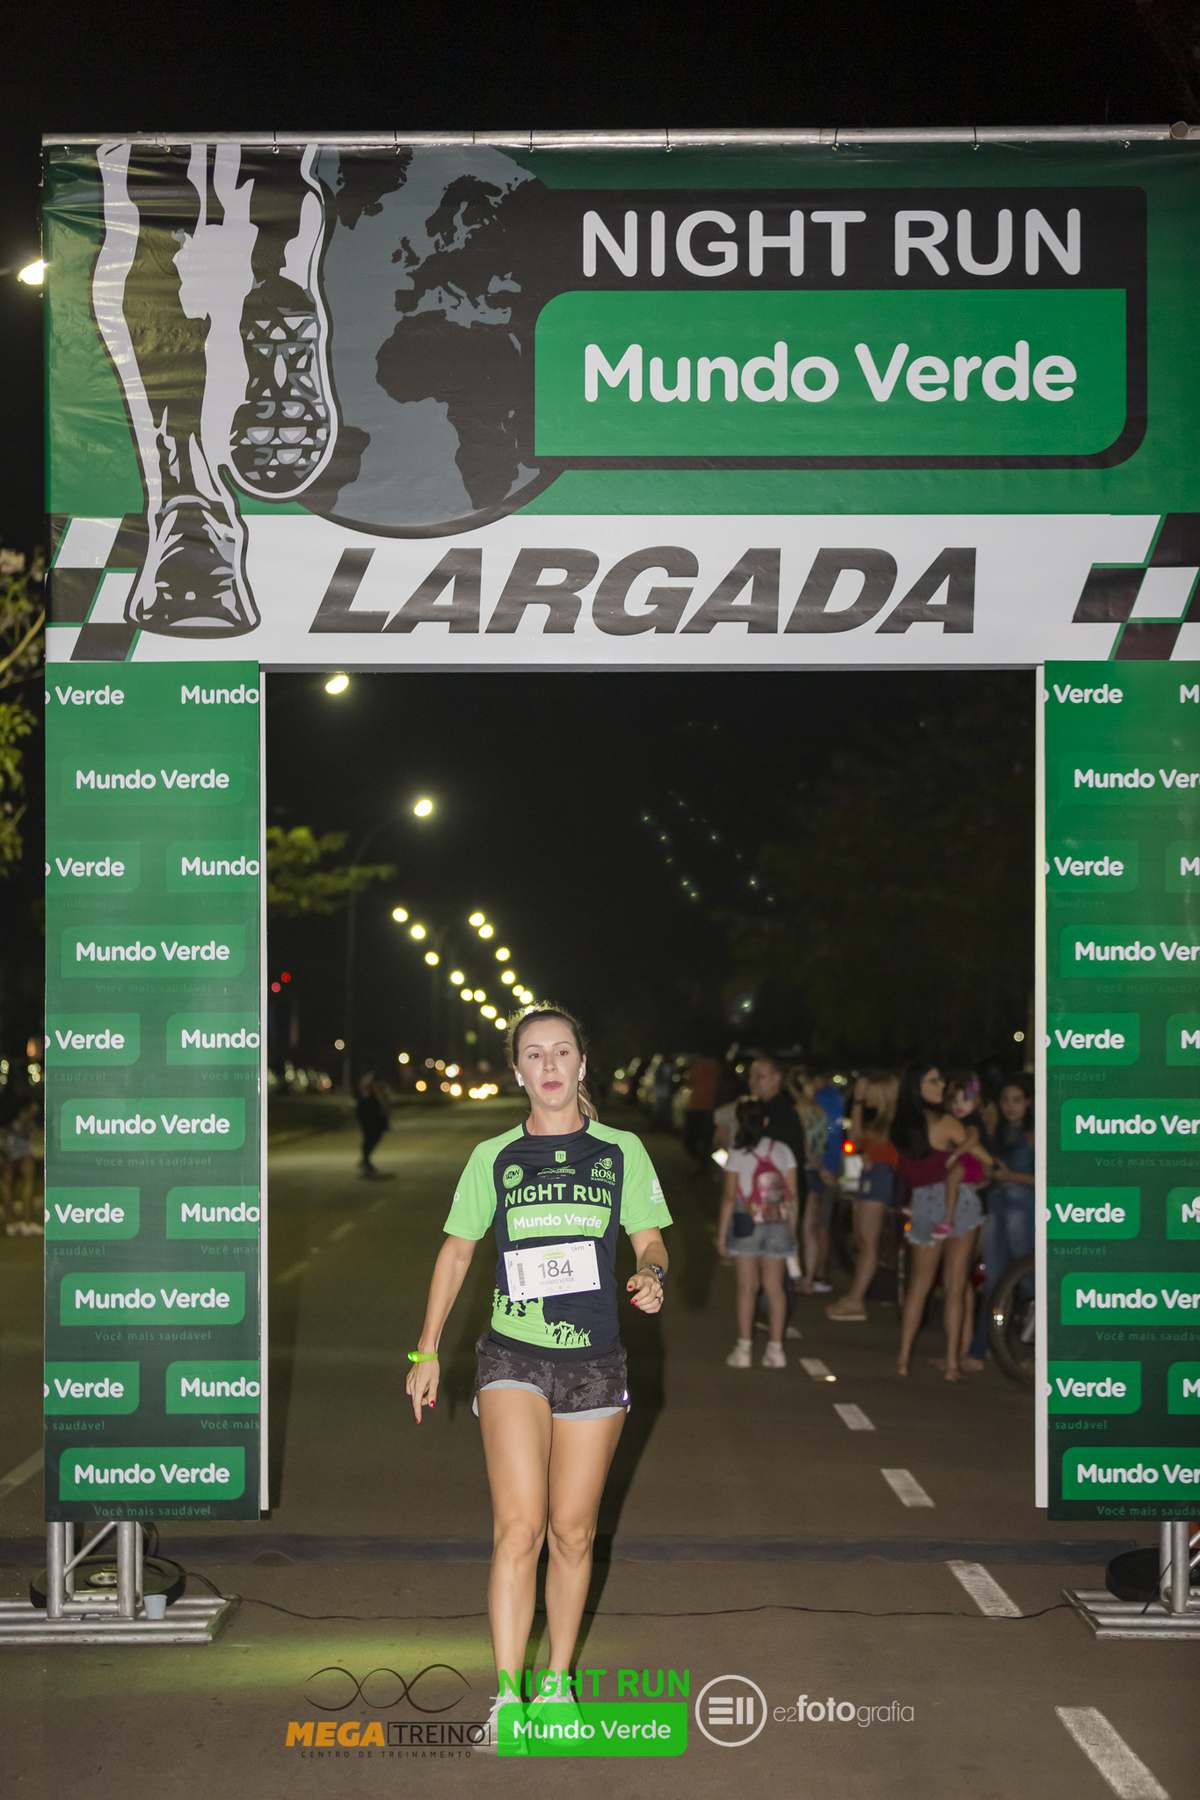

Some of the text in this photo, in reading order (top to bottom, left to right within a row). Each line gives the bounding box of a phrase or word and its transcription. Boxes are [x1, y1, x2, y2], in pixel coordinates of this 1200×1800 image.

[583, 208, 1081, 277] NIGHT RUN
[584, 340, 1077, 403] Mundo Verde
[309, 545, 977, 636] LARGADA
[55, 685, 124, 705] Verde
[180, 684, 259, 704] Mundo
[1054, 684, 1123, 704] Verde
[76, 769, 229, 789] Mundo Verde
[1074, 769, 1200, 789] Mundo Ver
[56, 857, 125, 877] Verde
[181, 856, 259, 876] Mundo
[1054, 856, 1123, 876] Verde
[76, 941, 230, 961] Mundo Verde
[1075, 941, 1200, 961] Mundo Ver
[55, 1029, 125, 1049] Verde
[181, 1028, 259, 1048] Mundo
[1055, 1028, 1124, 1048] Verde
[75, 1114, 230, 1134] Mundo Verde
[1075, 1114, 1200, 1134] Mundo Ver
[591, 1168, 616, 1182] ROSA
[505, 1183, 612, 1208] NIGHT RUN
[55, 1203, 124, 1223] Verde
[181, 1202, 260, 1222] Mundo
[513, 1213, 603, 1230] Mundo Verde
[1055, 1202, 1125, 1222] Verde
[53, 1245, 106, 1254] saudável
[201, 1244, 229, 1254] Você
[538, 1259, 574, 1279] 184
[539, 1276, 576, 1286] MUNDO VERDE
[75, 1288, 230, 1308] Mundo Verde
[1076, 1288, 1200, 1308] Mundo Ver
[95, 1331, 211, 1341] Você mais saudável
[1096, 1331, 1124, 1341] Você
[1128, 1332, 1156, 1341] mais
[54, 1378, 124, 1398] Verde
[180, 1377, 260, 1397] Mundo
[1056, 1377, 1126, 1397] Verde
[53, 1420, 105, 1430] saudável
[201, 1420, 228, 1429] Você
[1055, 1420, 1107, 1430] saudável
[74, 1463, 229, 1483] Mundo Verde
[1077, 1463, 1200, 1483] Mundo Ver
[94, 1507, 210, 1516] Você mais saudável
[1097, 1507, 1125, 1516] Você
[1130, 1508, 1156, 1516] mais
